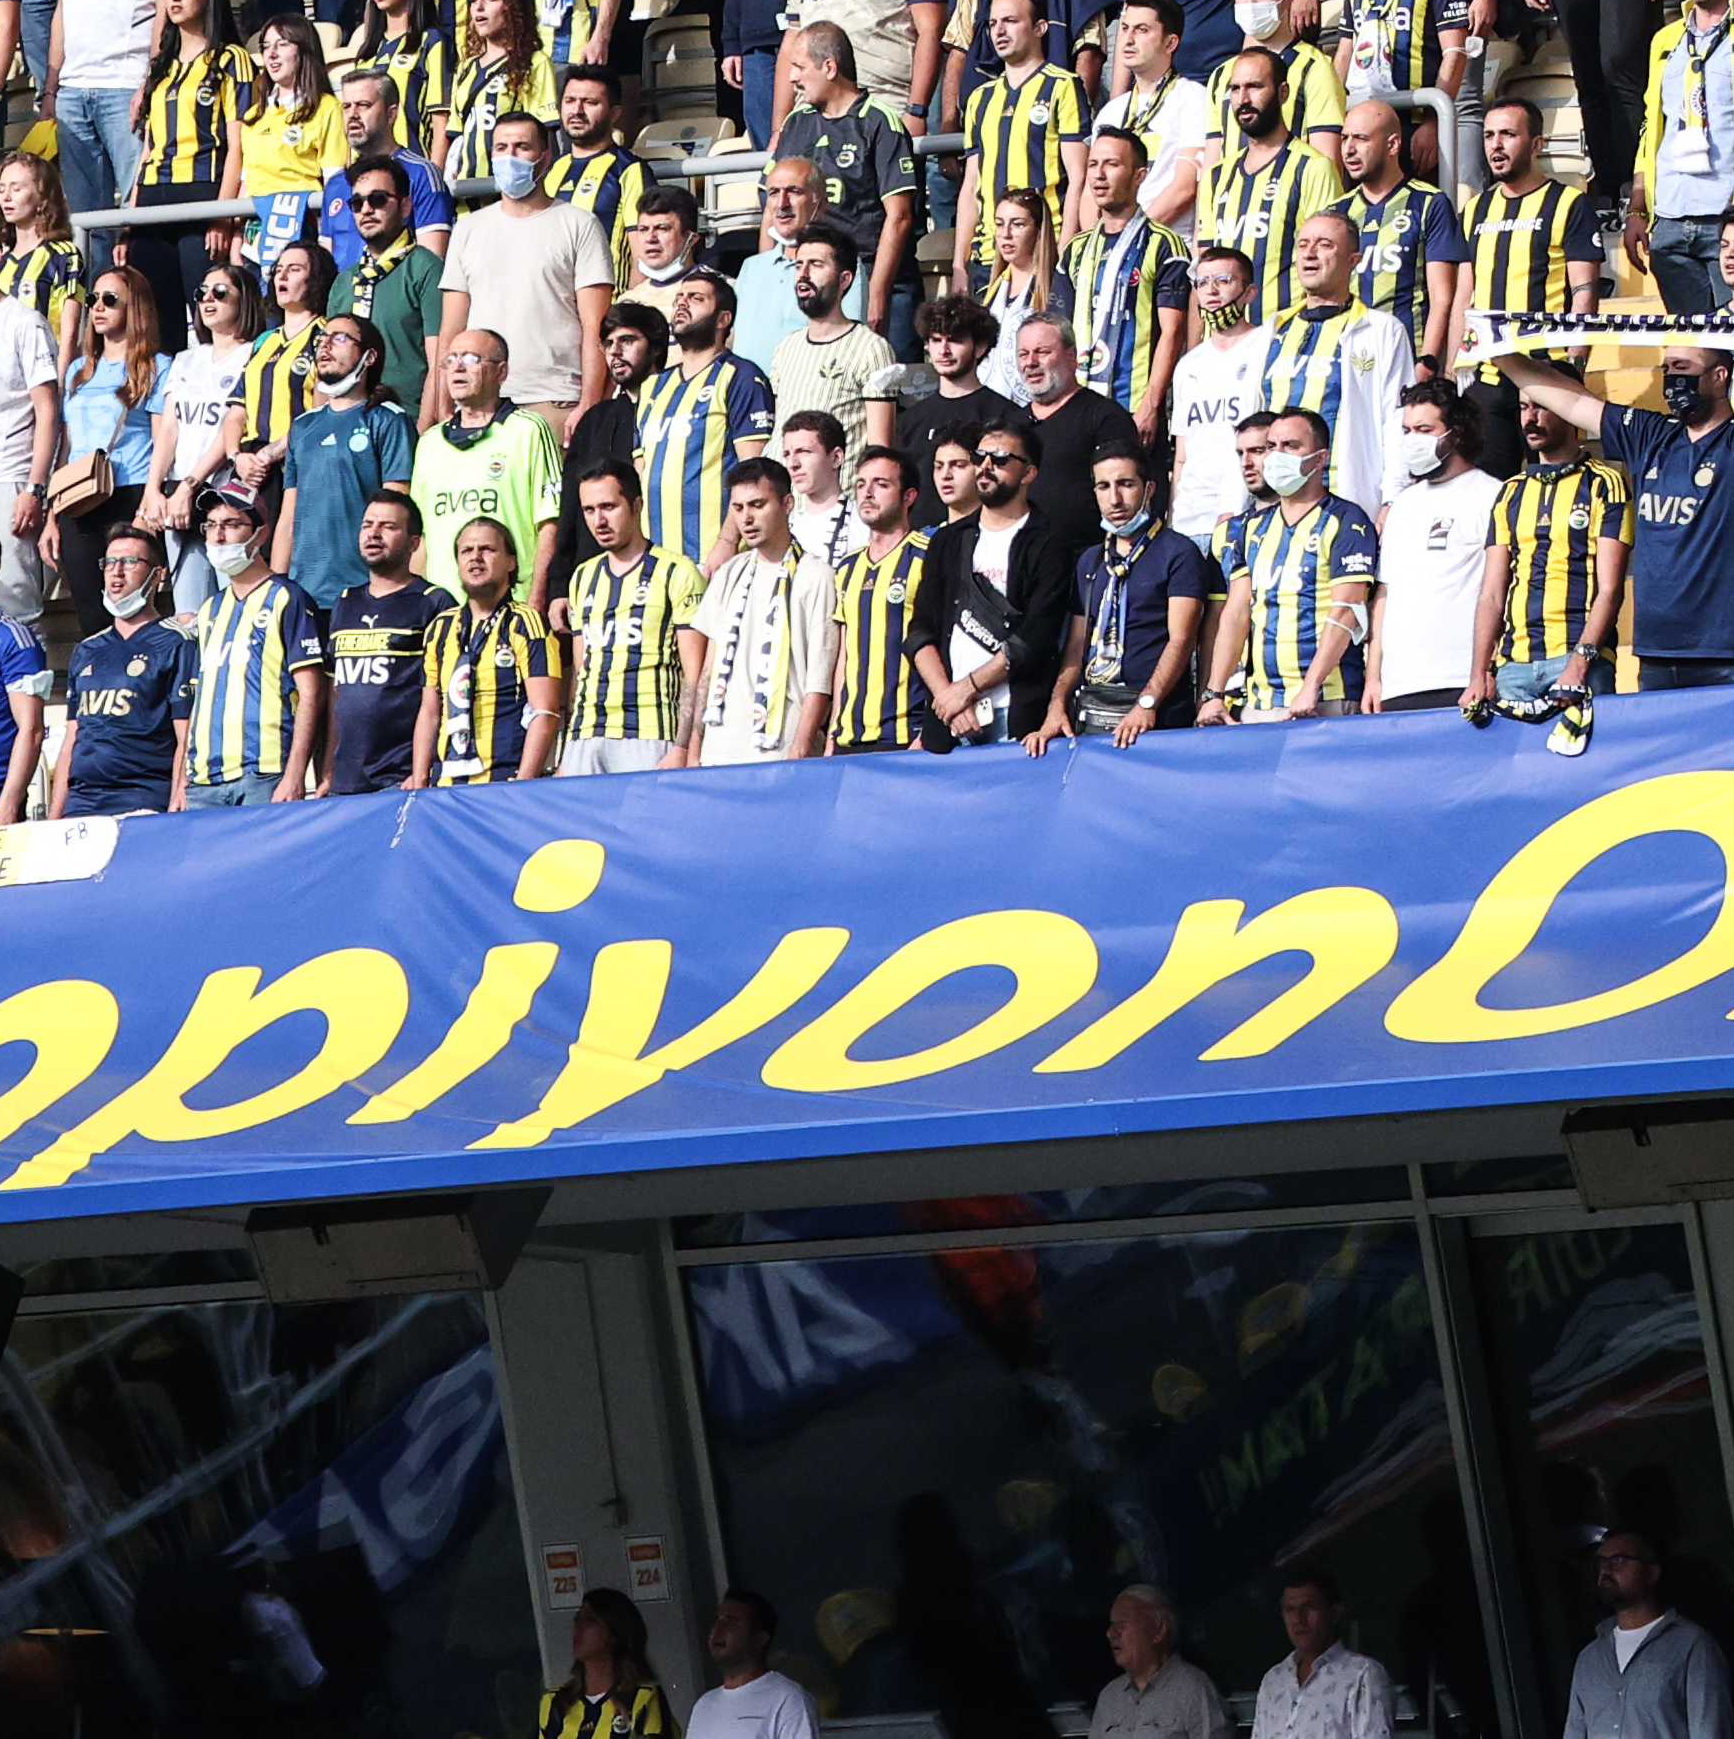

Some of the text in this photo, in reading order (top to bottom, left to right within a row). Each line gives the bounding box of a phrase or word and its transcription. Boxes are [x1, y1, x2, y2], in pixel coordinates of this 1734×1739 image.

[1215, 214, 1268, 240] AVIS
[1187, 396, 1240, 426] AVIS
[641, 413, 693, 442] AVIS
[434, 488, 498, 518] avea
[1637, 493, 1695, 525] AVIS
[1252, 567, 1302, 591] AVIS
[582, 616, 642, 651] AVIS
[333, 657, 389, 685] AVIS
[78, 690, 134, 717] AVIS
[552, 1575, 577, 1593] 225
